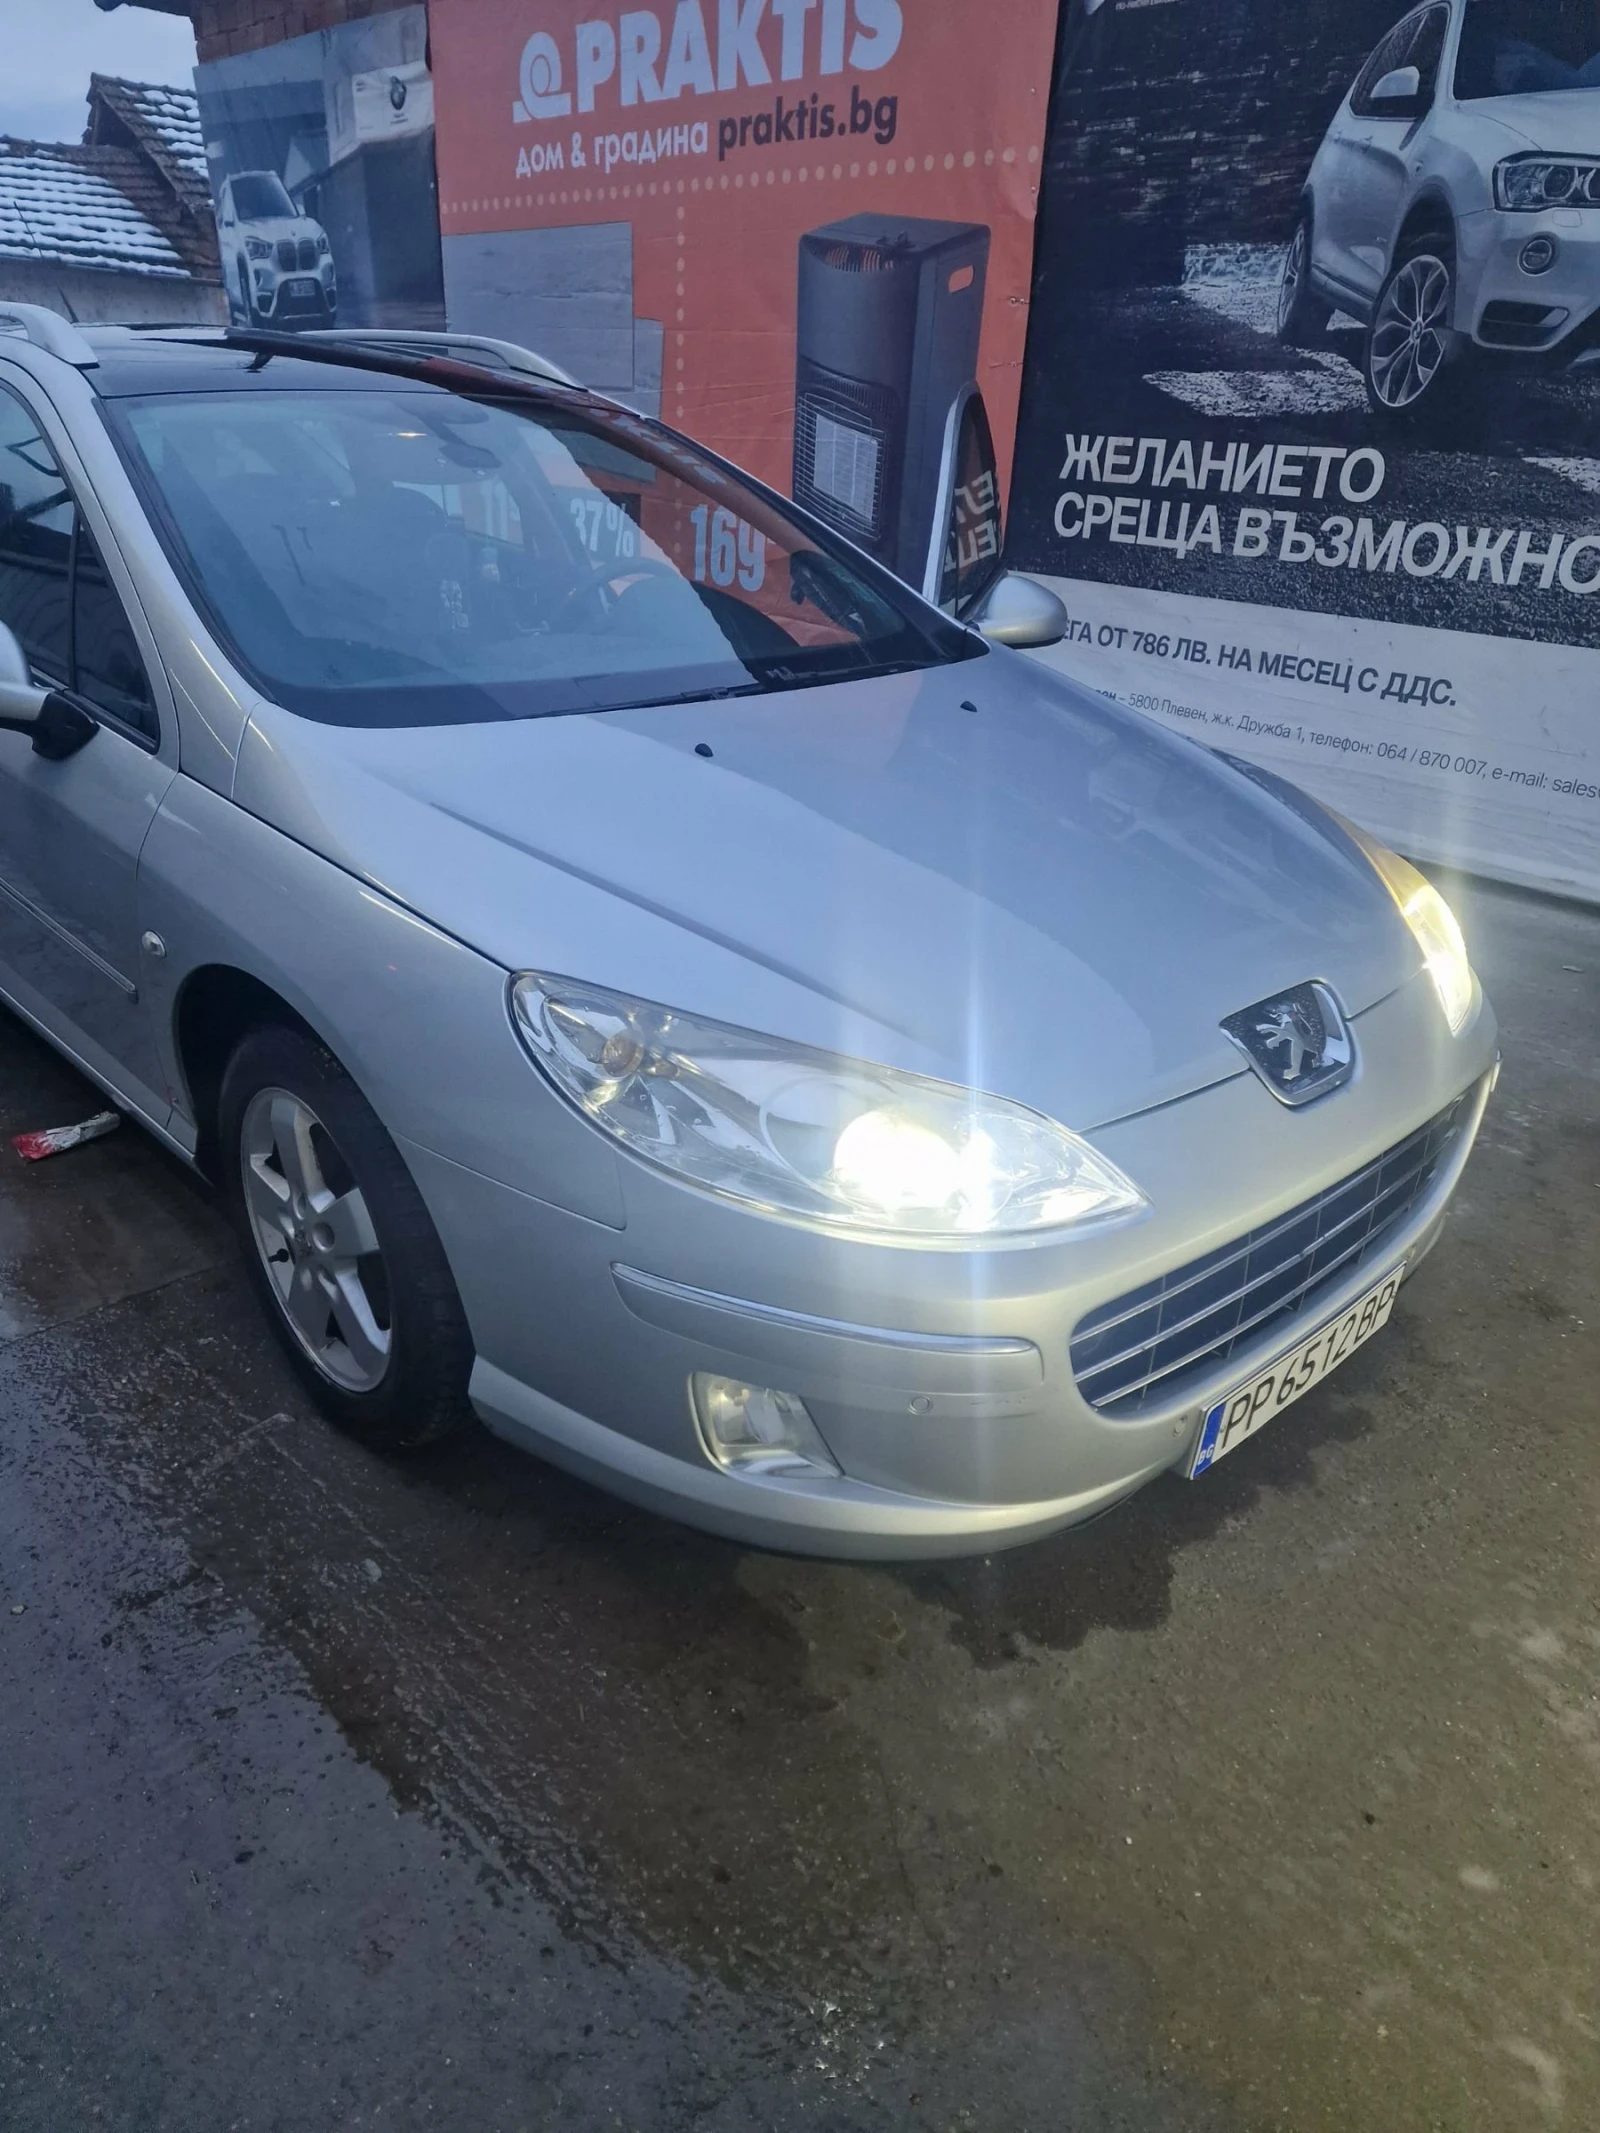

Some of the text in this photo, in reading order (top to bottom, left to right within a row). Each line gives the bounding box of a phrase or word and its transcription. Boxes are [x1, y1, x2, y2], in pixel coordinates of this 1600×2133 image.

[575, 0, 903, 113] PRAKTIS
[515, 85, 898, 178] дом & градина praktis.bg
[1059, 434, 1386, 503] ЖЕЛАНИЕТО
[1053, 492, 1222, 559] СРЕЩА
[1097, 625, 1130, 649] ОТ
[1132, 631, 1170, 657] 786
[1172, 638, 1211, 665] ЛВ.
[1217, 644, 1252, 672] НА
[1258, 651, 1353, 694] МЕСЕЦ
[1358, 668, 1379, 692] С
[1380, 671, 1457, 707] ДДС.
[1128, 693, 1159, 711] 5800
[1161, 700, 1208, 723] Плевен,
[1211, 712, 1235, 727] ж.к.
[1237, 715, 1291, 739] Дружба
[1296, 727, 1305, 743] 1,
[1310, 731, 1374, 755] телефон:
[1377, 742, 1407, 761] 064
[1419, 750, 1451, 770] 870
[1454, 757, 1488, 779] 007,
[1491, 766, 1549, 789] e-mail:
[1552, 777, 1600, 799] sales
